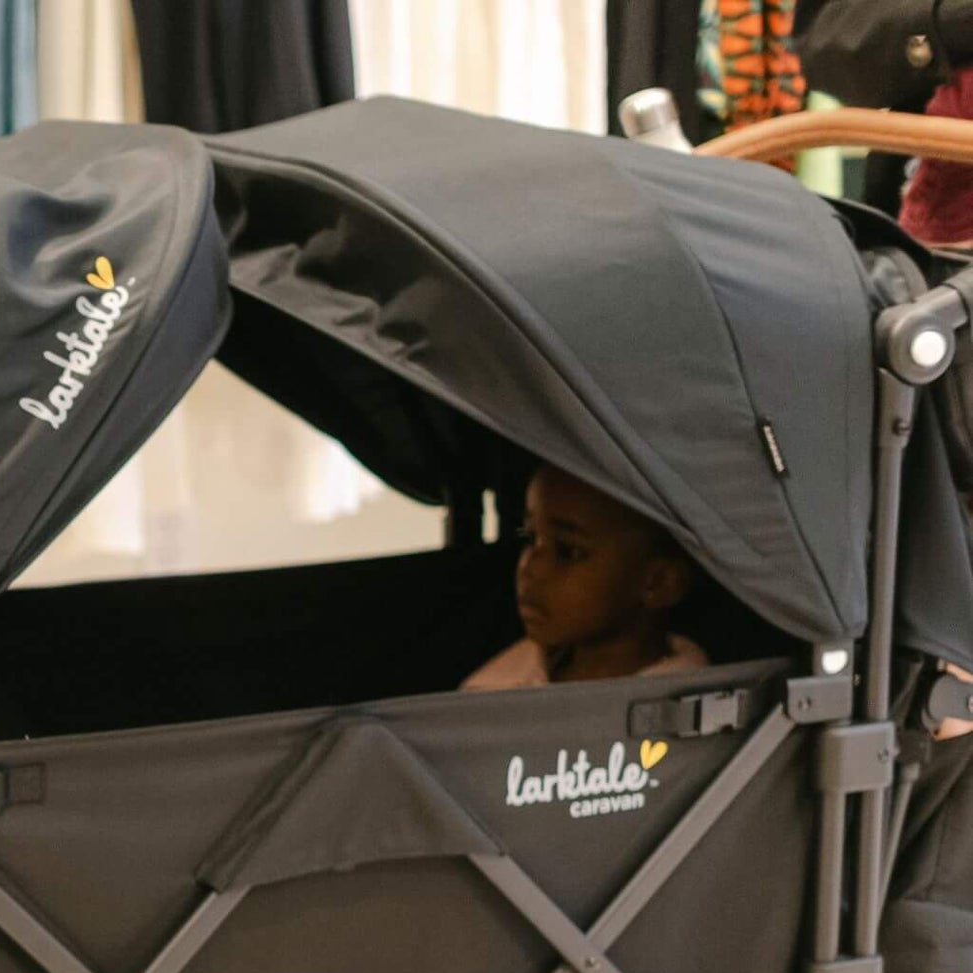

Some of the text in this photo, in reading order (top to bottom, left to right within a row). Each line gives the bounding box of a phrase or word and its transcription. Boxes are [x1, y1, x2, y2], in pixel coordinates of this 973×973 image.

[19, 286, 128, 429] larktale
[506, 741, 648, 806] larktale
[570, 792, 645, 818] caravan
